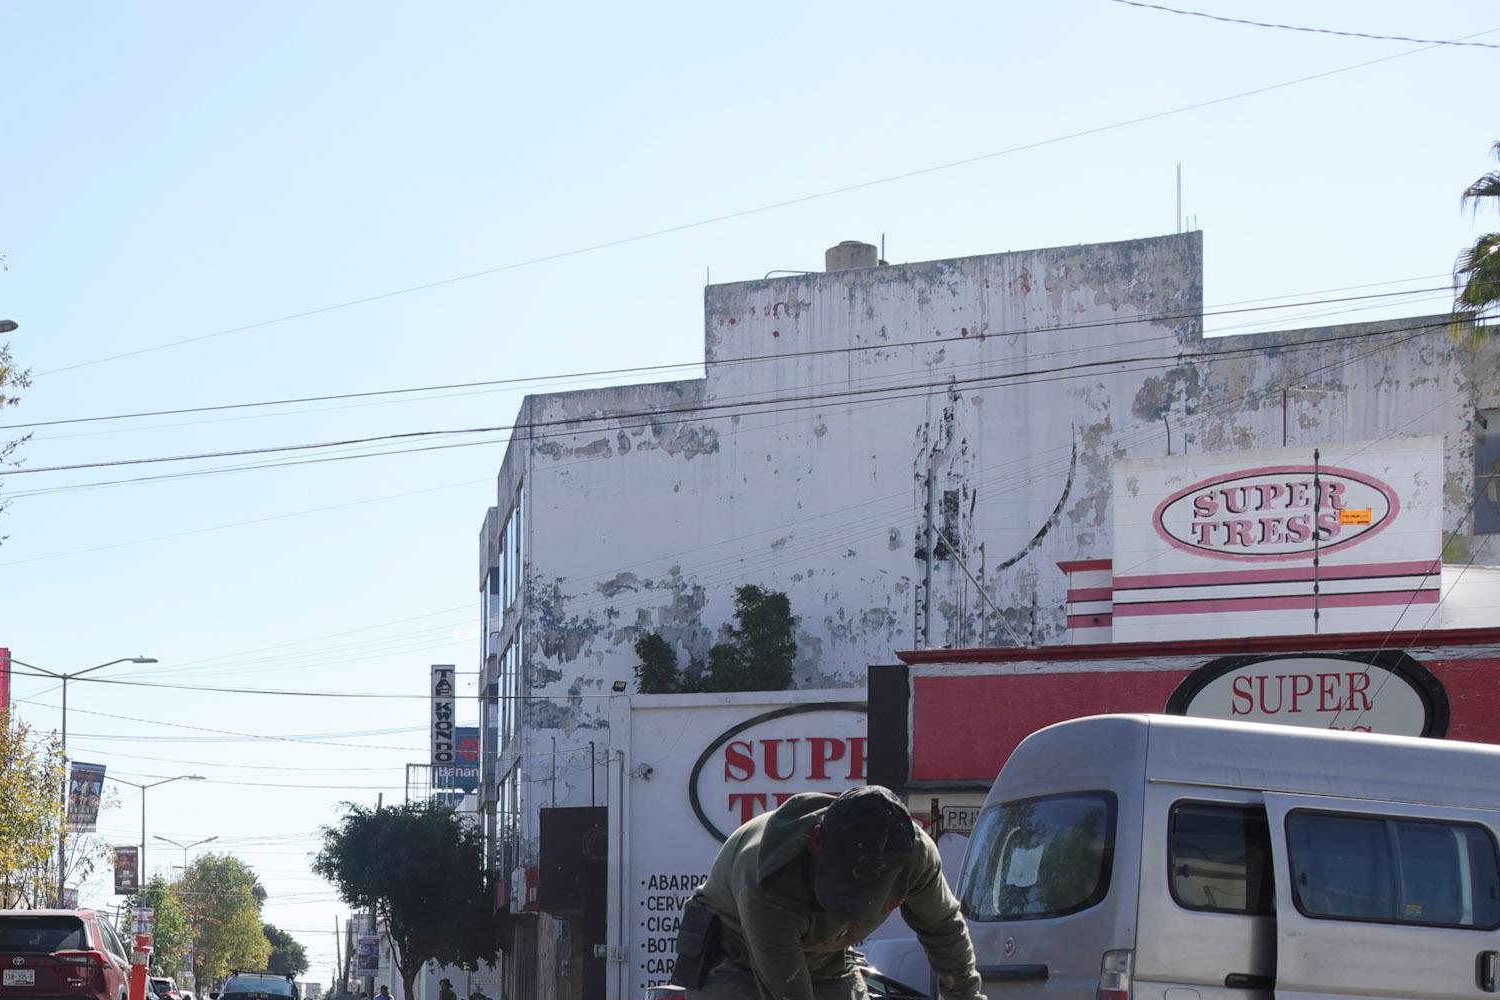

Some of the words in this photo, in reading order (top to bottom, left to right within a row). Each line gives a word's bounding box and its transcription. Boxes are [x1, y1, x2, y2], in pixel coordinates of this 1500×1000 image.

[1193, 481, 1347, 519] SUPER
[1190, 510, 1342, 547] TRESS
[1231, 671, 1374, 716] SUPER
[647, 896, 691, 911] CERV
[647, 916, 680, 932] CIGA
[647, 938, 677, 953] BOT
[646, 958, 675, 974] CAR
